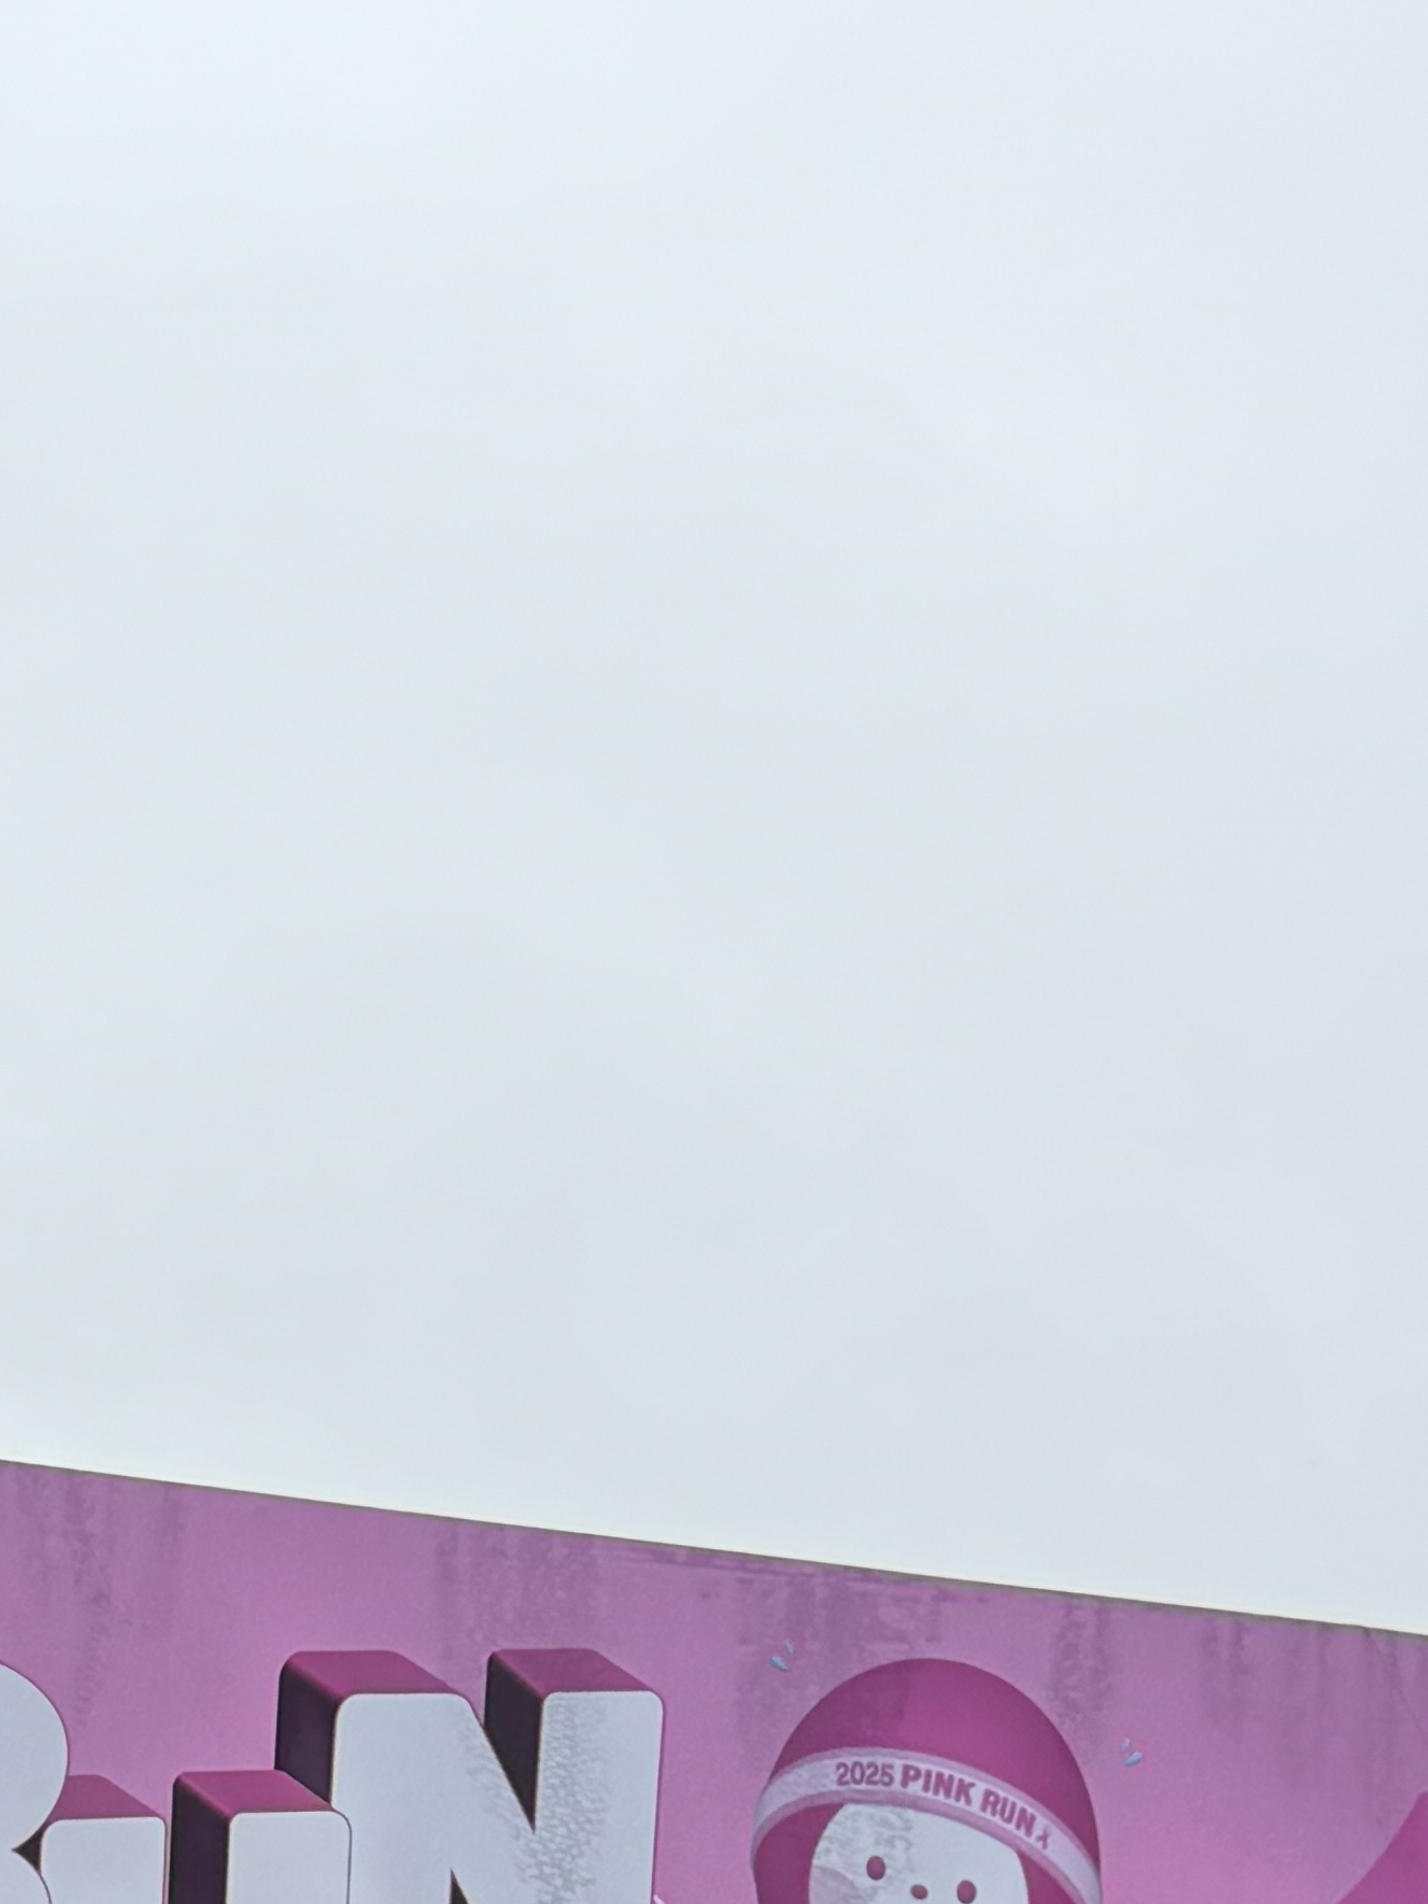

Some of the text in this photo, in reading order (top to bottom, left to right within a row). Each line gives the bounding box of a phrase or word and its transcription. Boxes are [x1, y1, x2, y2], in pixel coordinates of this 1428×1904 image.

[835, 1761, 1037, 1840] 2025 PINK RUN
